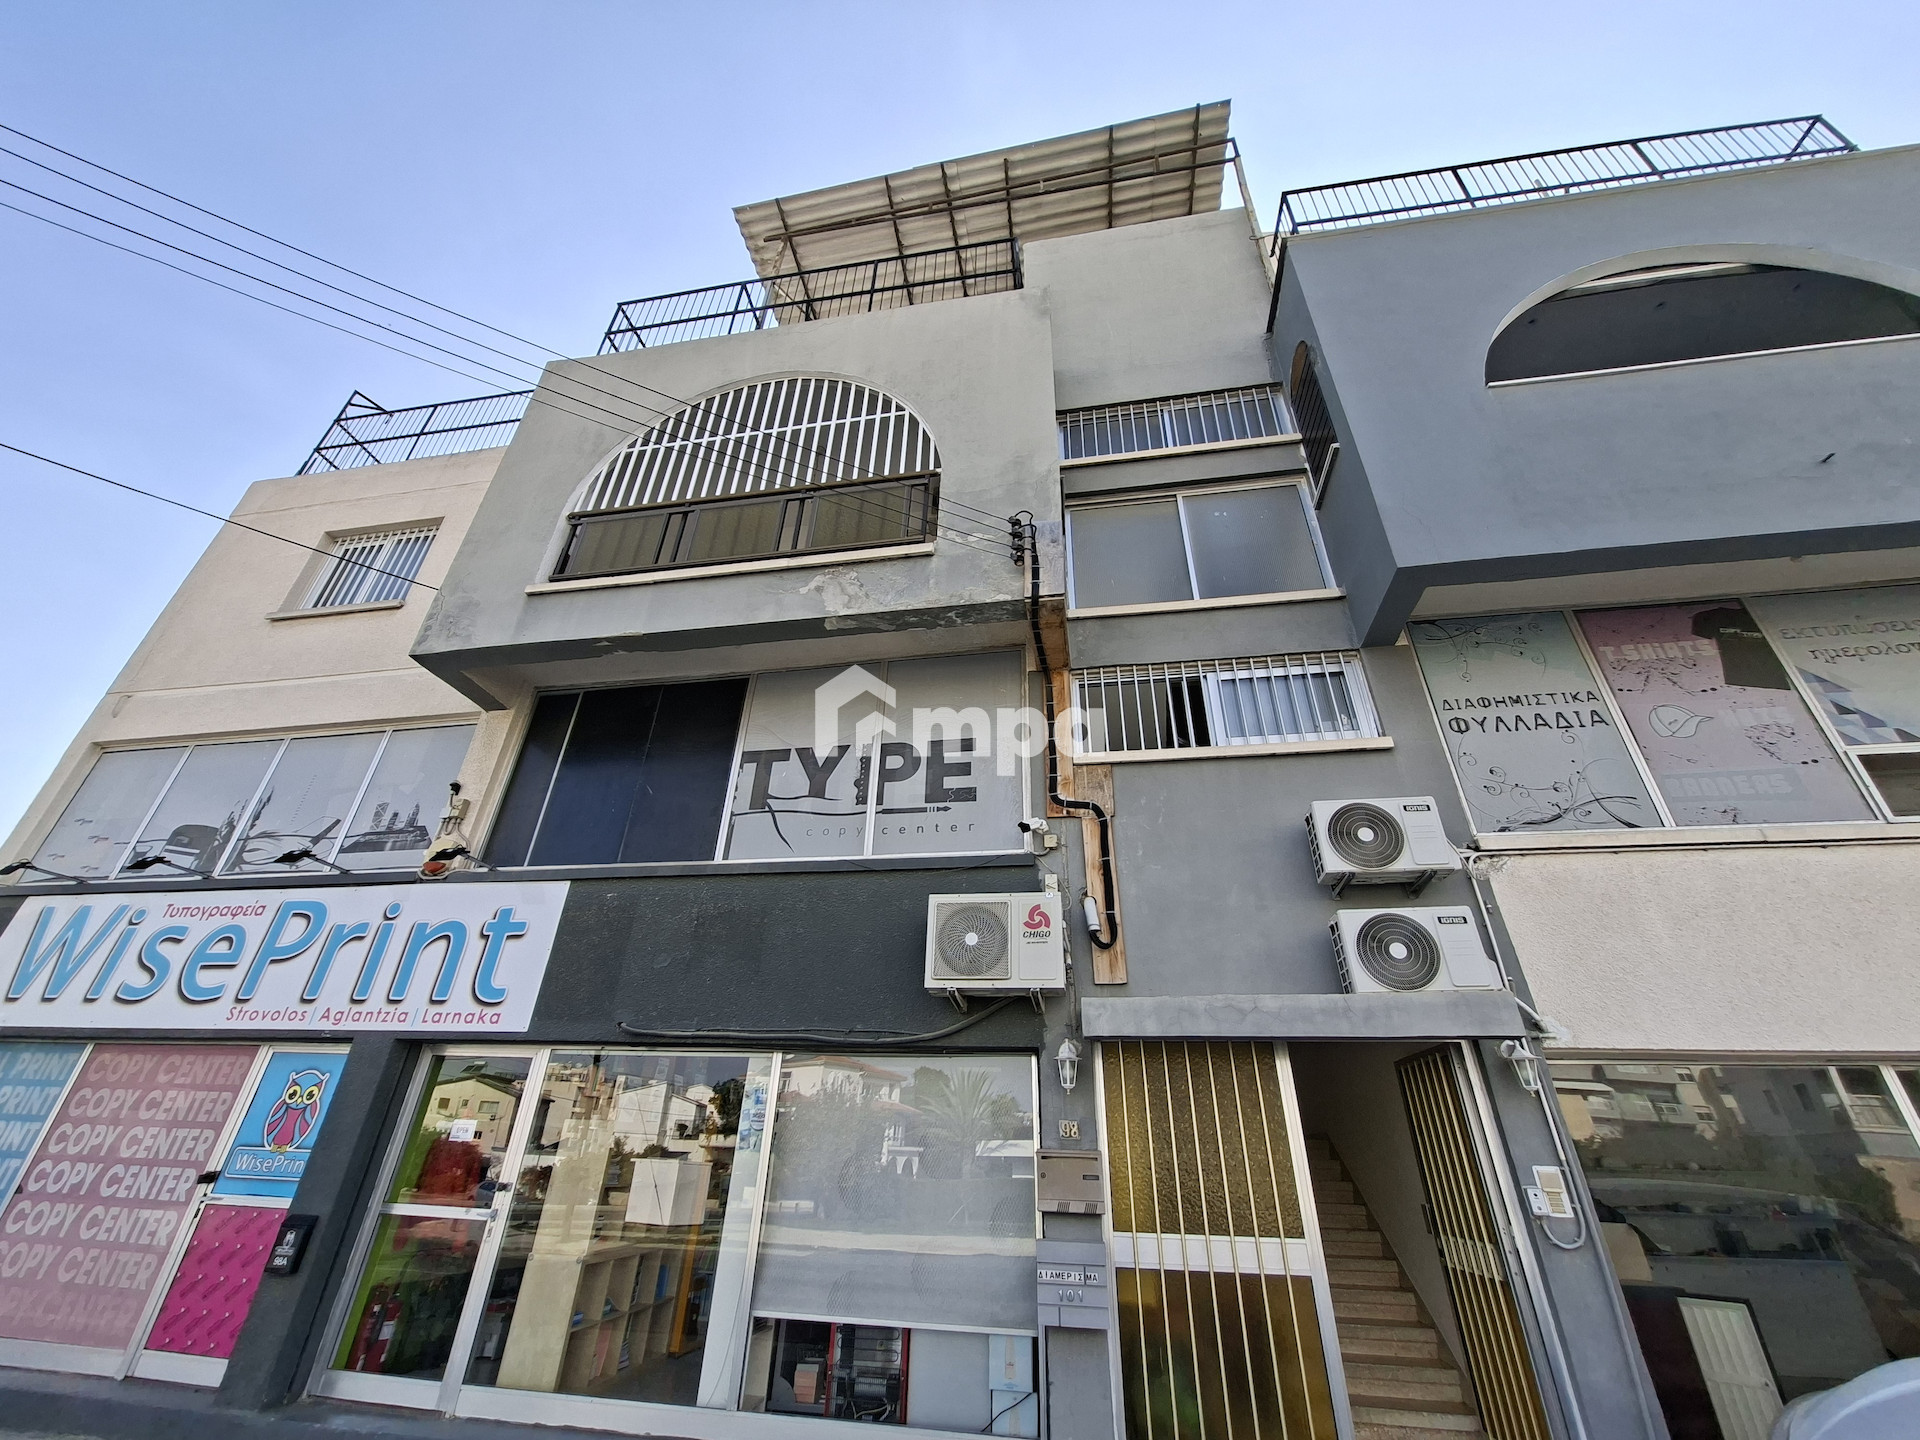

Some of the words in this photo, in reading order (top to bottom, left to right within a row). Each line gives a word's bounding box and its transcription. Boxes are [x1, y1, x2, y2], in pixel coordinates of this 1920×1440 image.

[1442, 690, 1600, 711] ΔΙΑΦΗΜΙΣΤΙΚΑ
[1448, 709, 1610, 735] ΦΥΛΛΑΔΙΑ
[741, 738, 977, 810] TYPE
[806, 825, 863, 838] copy
[881, 822, 975, 835] center
[162, 900, 267, 922] Τυπογραφεία
[1023, 930, 1051, 938] CHIGO
[6, 899, 529, 1004] WisePrint
[226, 1006, 307, 1023] Strovolos
[318, 1007, 410, 1026] Aglantzia
[421, 1008, 501, 1026] Larnaka
[9, 1052, 80, 1081] PRINT
[88, 1053, 153, 1083] COPY
[158, 1054, 250, 1085] CENTER
[68, 1087, 142, 1119] COPY
[138, 1089, 234, 1122] CENTER
[48, 1122, 127, 1156] COPY
[120, 1125, 216, 1161] CENTER
[1061, 1121, 1079, 1138] 98
[235, 1153, 305, 1174] WisePrin
[27, 1159, 103, 1196] COPY
[100, 1164, 197, 1202] CENTER
[5, 1200, 84, 1238] COPY
[80, 1205, 178, 1247] CENTER
[57, 1246, 158, 1290] CENTER
[1058, 1289, 1083, 1302] 101
